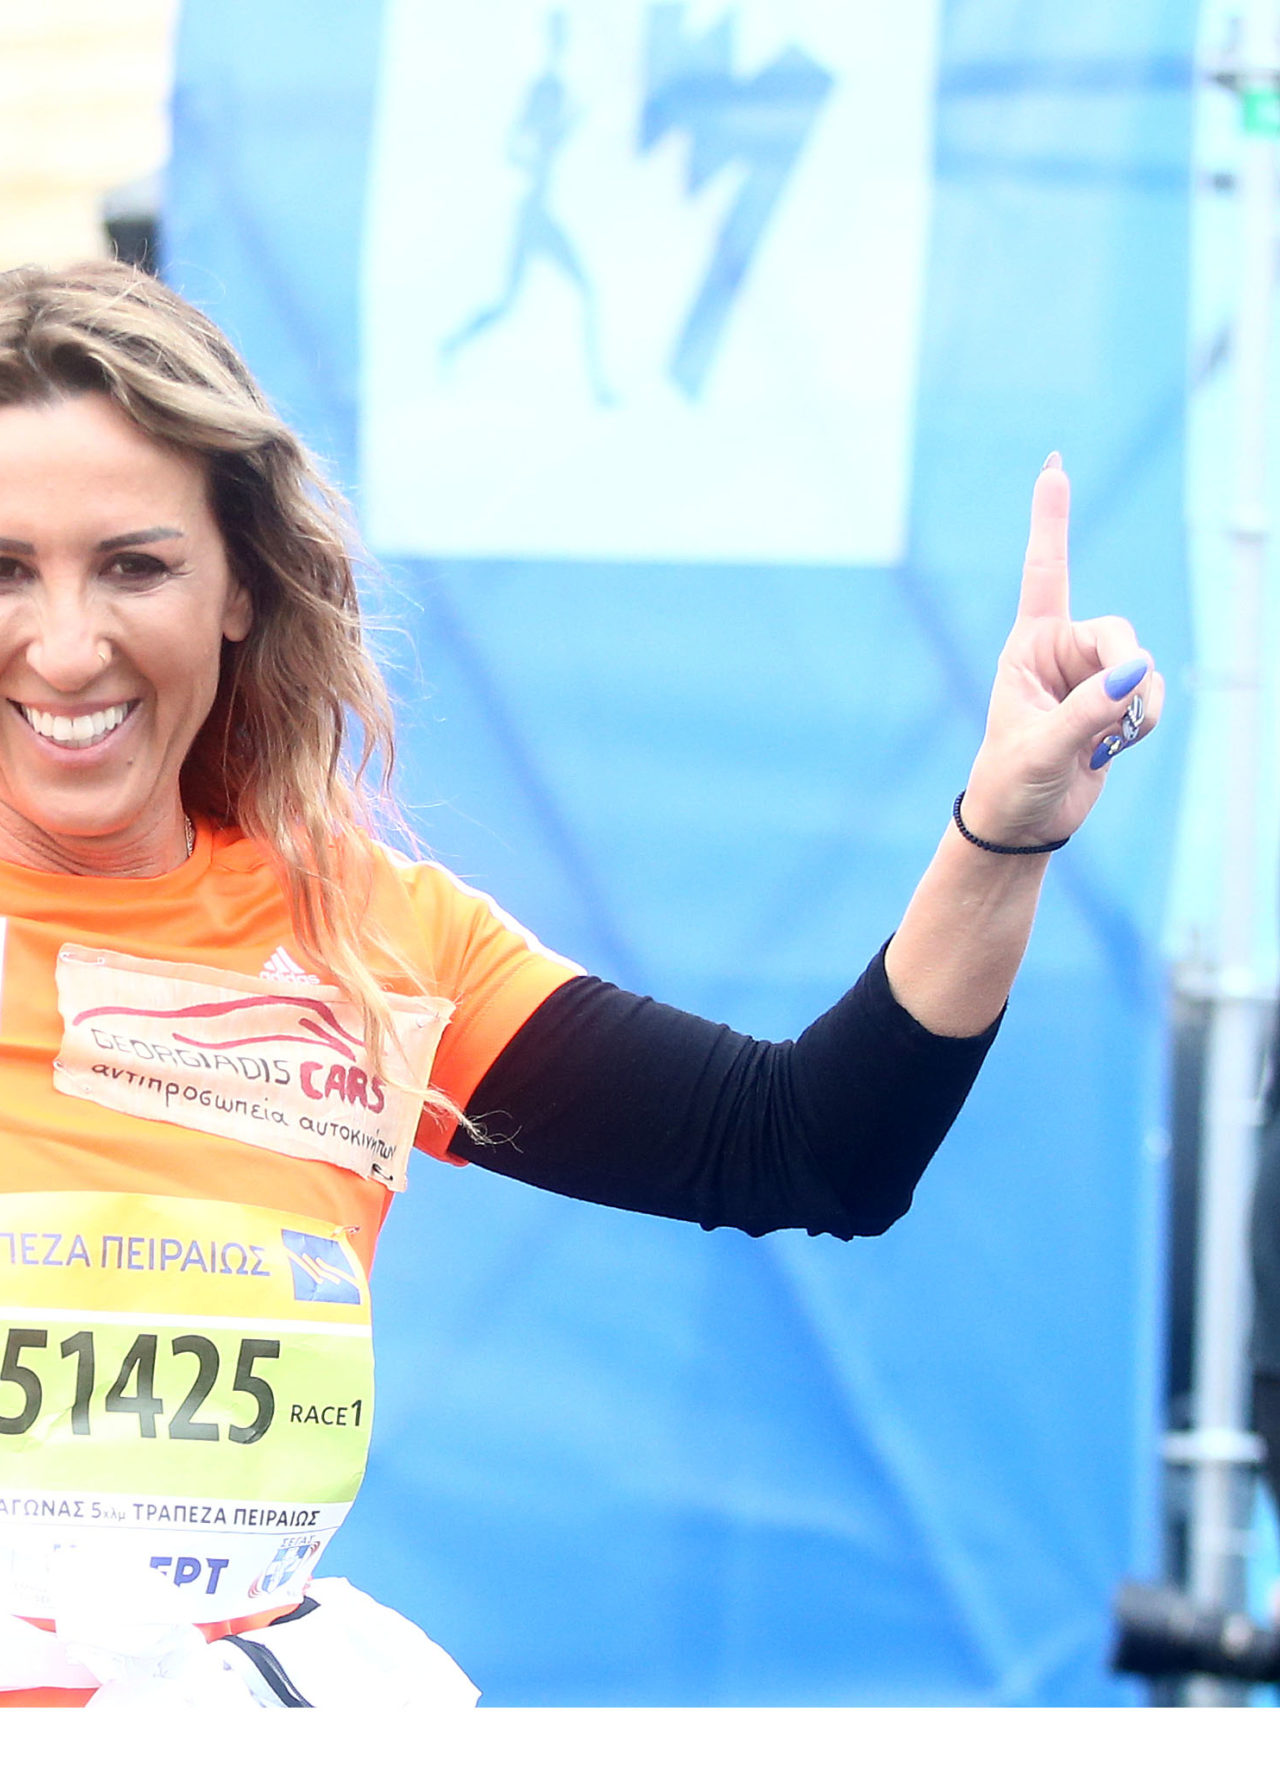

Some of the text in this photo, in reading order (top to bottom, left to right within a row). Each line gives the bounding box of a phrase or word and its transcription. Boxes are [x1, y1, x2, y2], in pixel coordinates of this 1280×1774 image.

[259, 971, 320, 985] adidas
[91, 1028, 387, 1114] GEORGIADIS CARS
[101, 1235, 271, 1277] ΠΕΙΡΑΙΩΣ
[133, 1503, 227, 1525] ΤΡΑΠΕΖΑ
[233, 1508, 320, 1527] ΠΕΙΡΑΙΩΣ
